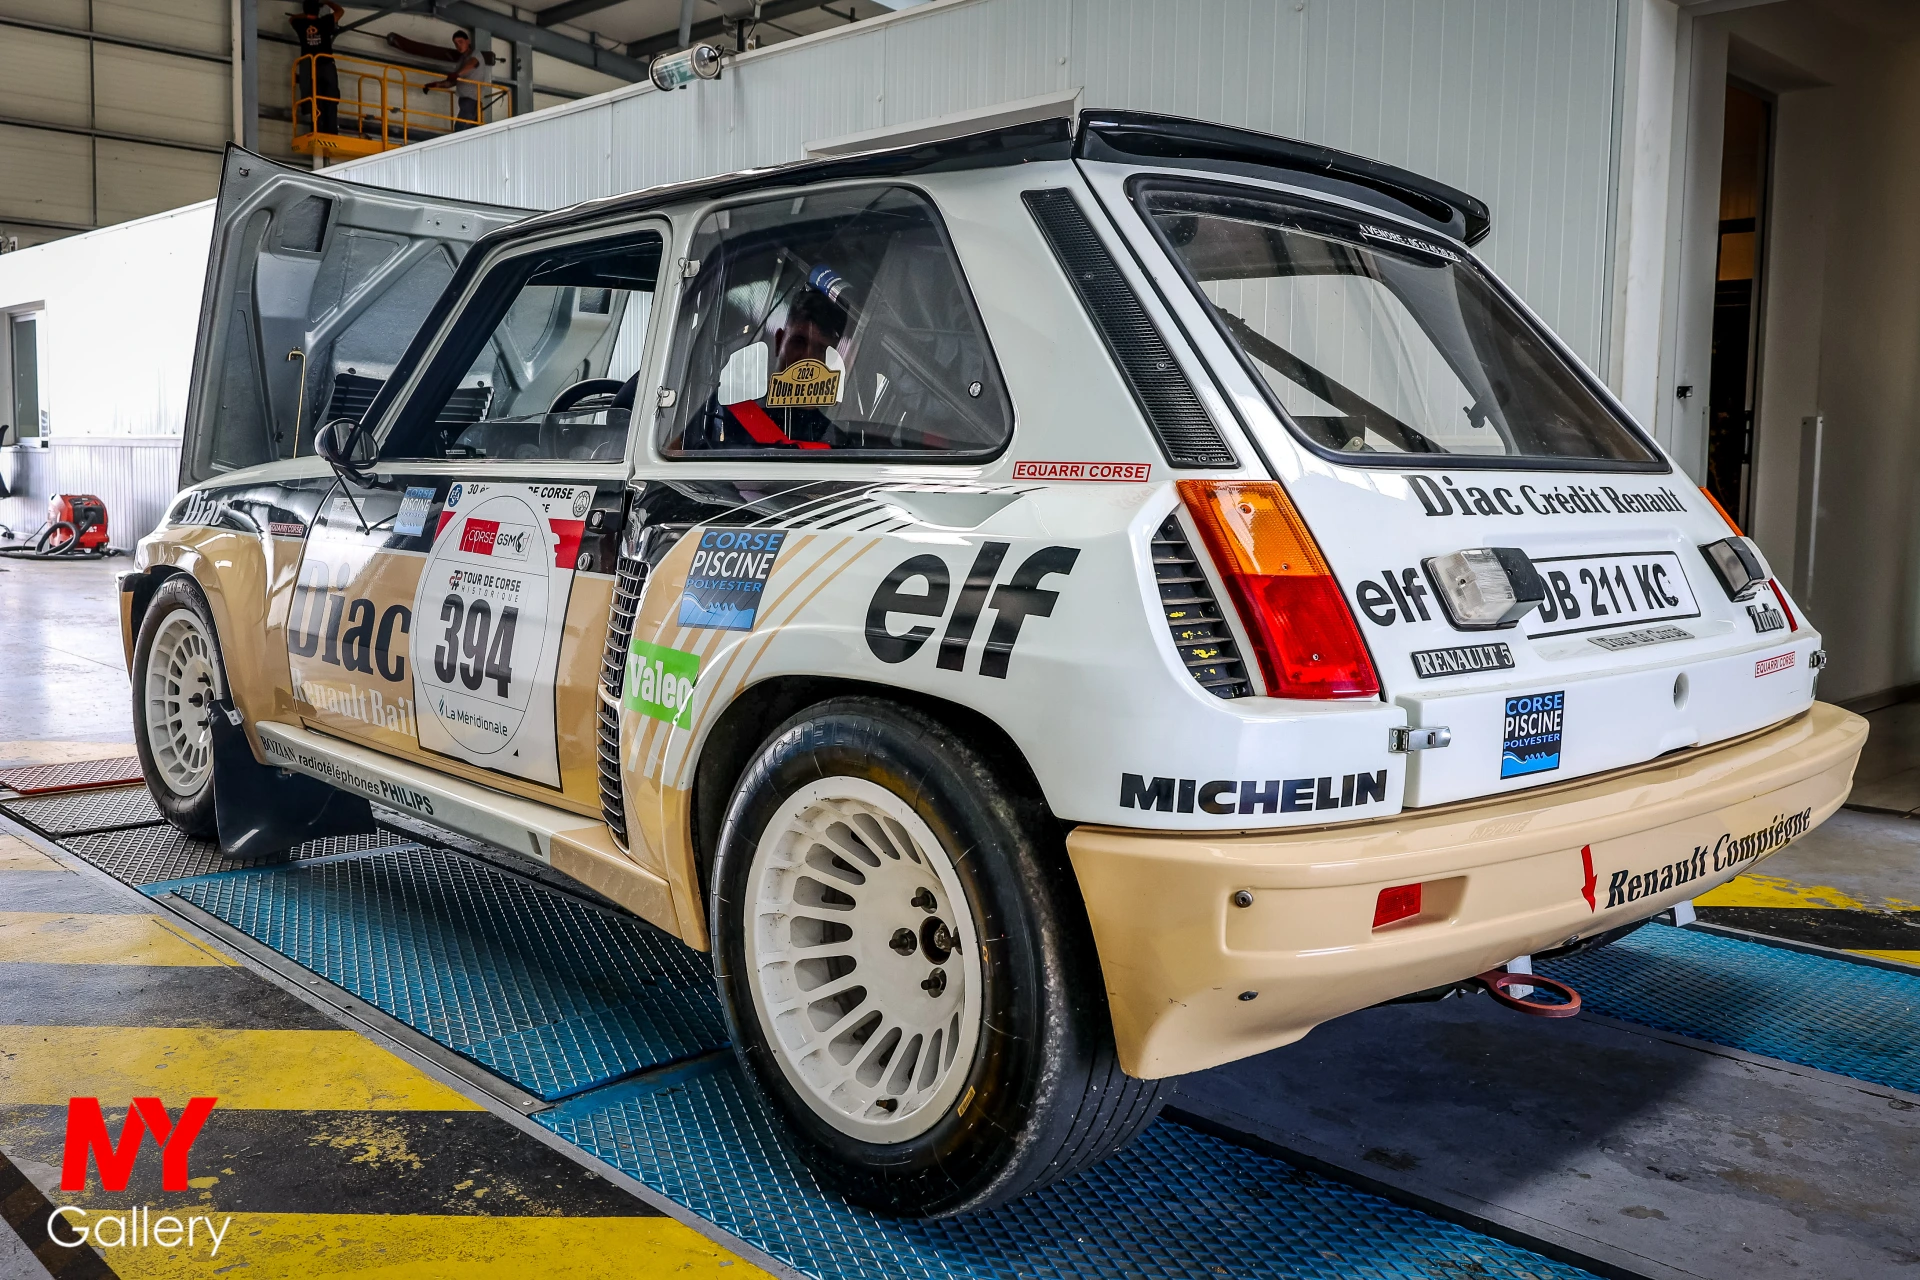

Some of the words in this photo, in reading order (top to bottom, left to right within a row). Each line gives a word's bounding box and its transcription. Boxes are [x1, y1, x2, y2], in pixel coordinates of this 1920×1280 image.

[771, 378, 794, 397] TOUR
[795, 382, 805, 396] DE
[806, 375, 837, 396] CORSE
[797, 367, 815, 380] 2024
[1016, 464, 1085, 478] EQUARRI
[1088, 465, 1146, 479] CORSE
[400, 497, 432, 512] PISCINE
[405, 488, 435, 498] CORSE
[467, 484, 479, 495] 30
[540, 487, 575, 500] CORSE
[1401, 474, 1523, 517] Diac
[1519, 483, 1612, 517] Crédit
[1599, 486, 1688, 515] Renault
[180, 489, 229, 527] Diac
[468, 529, 496, 545] CORSE
[496, 533, 516, 547] GSM
[700, 531, 784, 551] CORSE
[689, 550, 775, 579] PISCINE
[460, 586, 519, 603] HISTORIQUE
[462, 571, 482, 586] TOUR
[484, 575, 494, 588] DE
[494, 577, 522, 593] CORSE
[686, 578, 763, 593] POLYESTER
[1355, 567, 1432, 627] elf
[1579, 565, 1637, 617] 211
[1632, 562, 1679, 609] KC
[288, 559, 413, 683] Diac
[864, 541, 1082, 680] elf
[1745, 602, 1785, 634] Turbo
[434, 593, 519, 699] 394
[1416, 646, 1501, 676] RENAULT
[1500, 643, 1514, 667] 5
[1756, 658, 1779, 675] EQUARRI
[1779, 654, 1795, 670] CORSE
[290, 666, 370, 725] Renault
[628, 651, 695, 713] Valeo
[1505, 693, 1564, 717] CORSE
[445, 704, 456, 720] La
[456, 709, 509, 737] Méridionale
[1504, 709, 1562, 739] PISCINE
[1503, 732, 1561, 750] POLYESTER
[260, 735, 298, 763] BOZIAN
[298, 754, 381, 796] radiotéléphones
[379, 779, 434, 816] PHILIPS
[1119, 769, 1388, 815] MICHELIN
[1604, 845, 1708, 909] Renault
[1712, 806, 1812, 873] Compiègne
